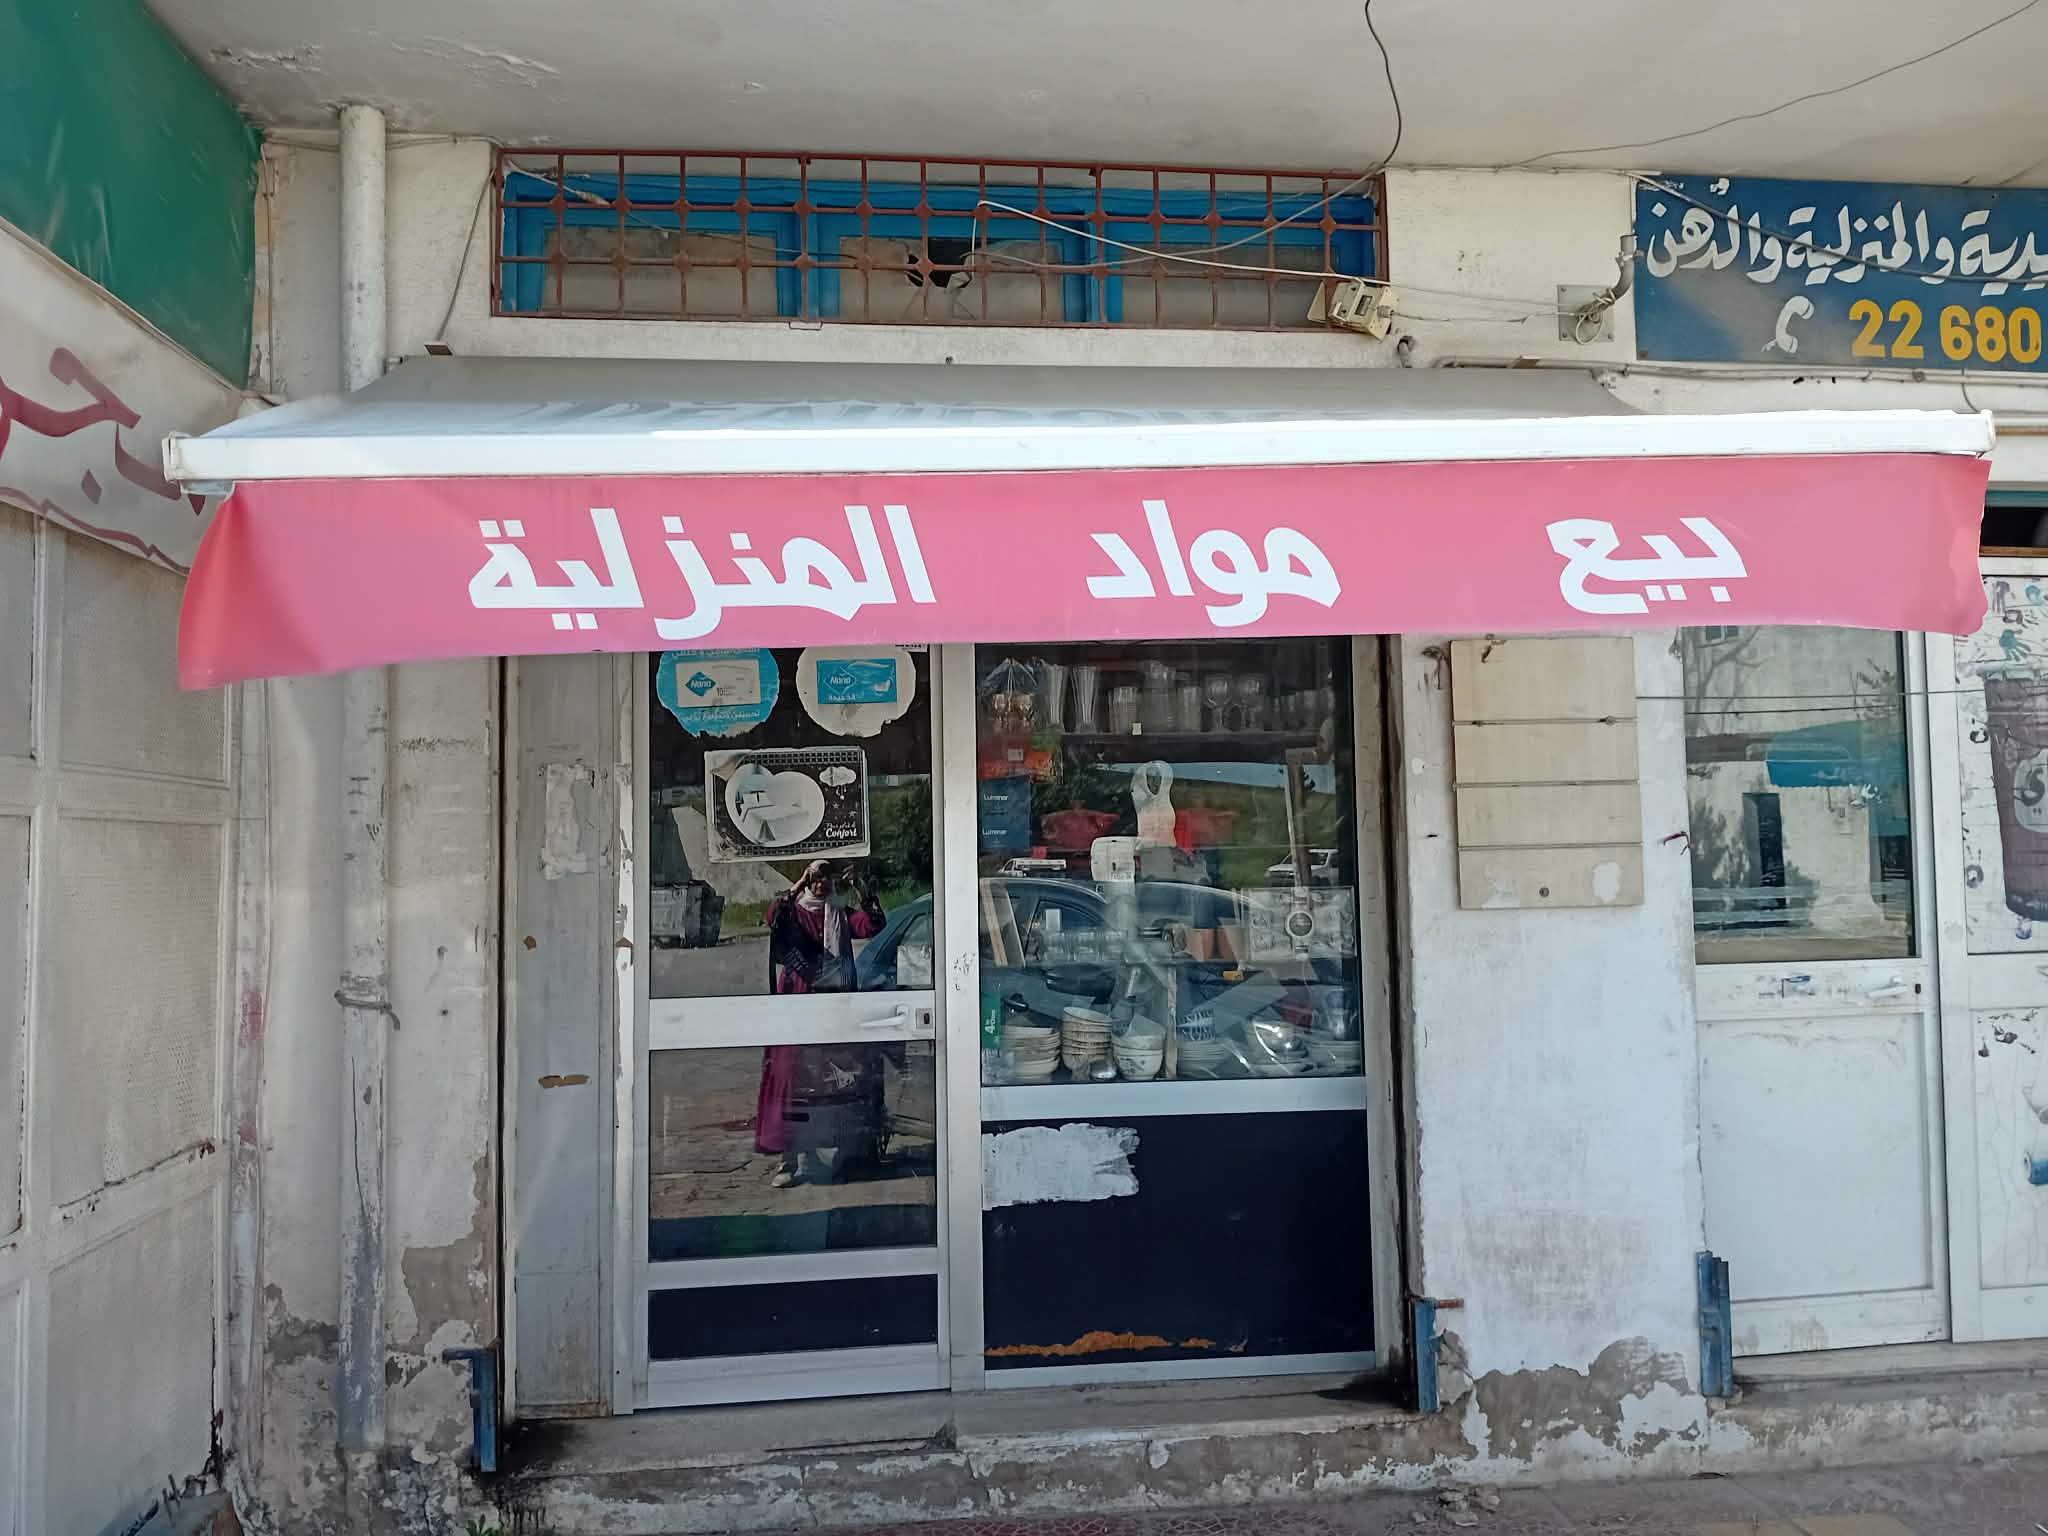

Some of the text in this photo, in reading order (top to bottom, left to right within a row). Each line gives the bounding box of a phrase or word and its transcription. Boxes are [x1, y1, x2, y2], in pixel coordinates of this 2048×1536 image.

[1849, 299, 2042, 363] 22 680
[468, 499, 1748, 641] بيع مواد المنزلية
[826, 828, 857, 839] Confort
